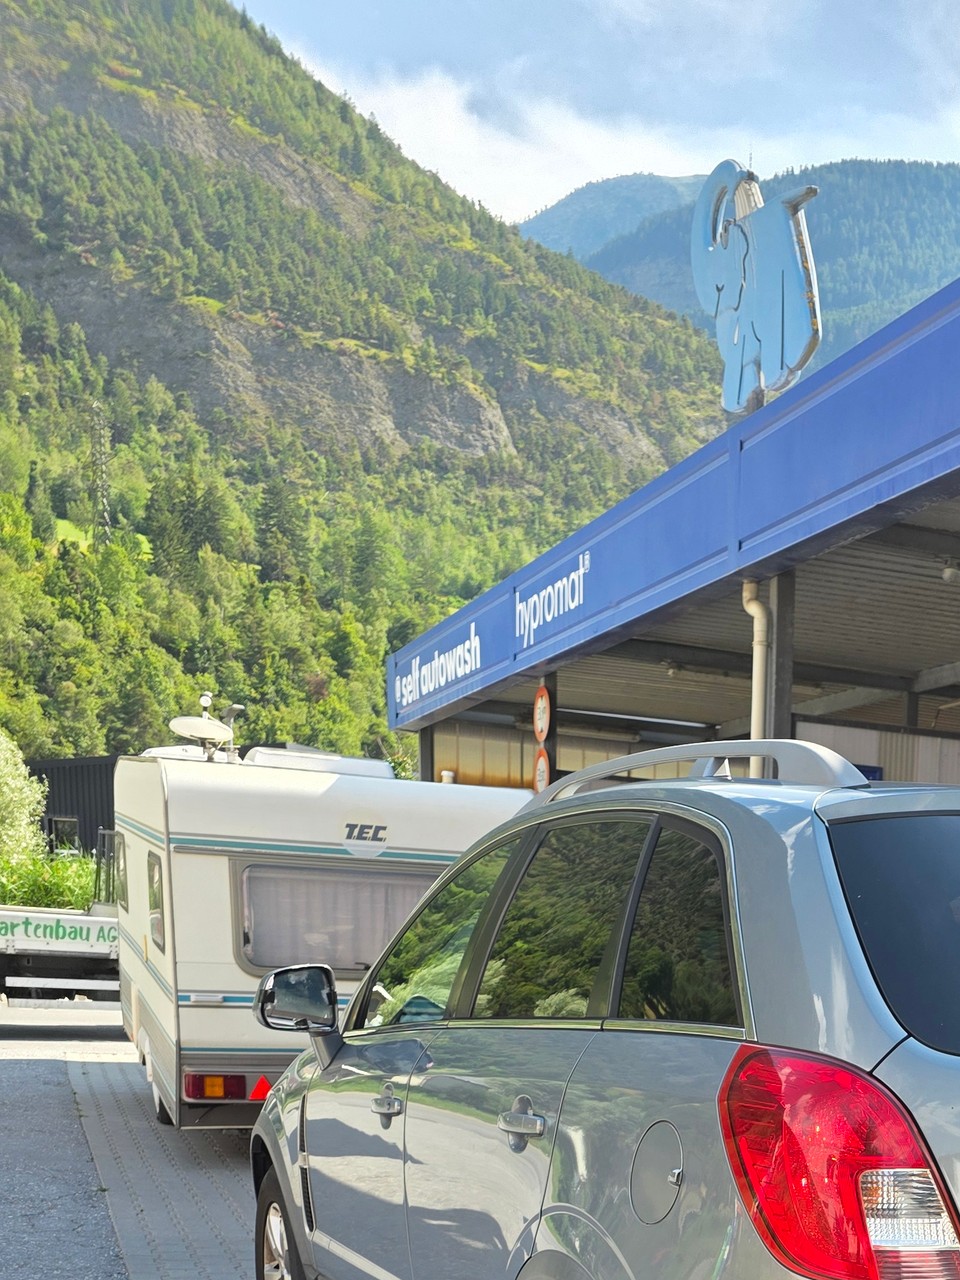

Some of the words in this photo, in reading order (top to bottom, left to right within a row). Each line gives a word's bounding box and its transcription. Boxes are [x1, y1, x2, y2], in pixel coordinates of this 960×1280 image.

[402, 655, 420, 706] self
[420, 622, 481, 696] autowash
[96, 925, 119, 943] AG
